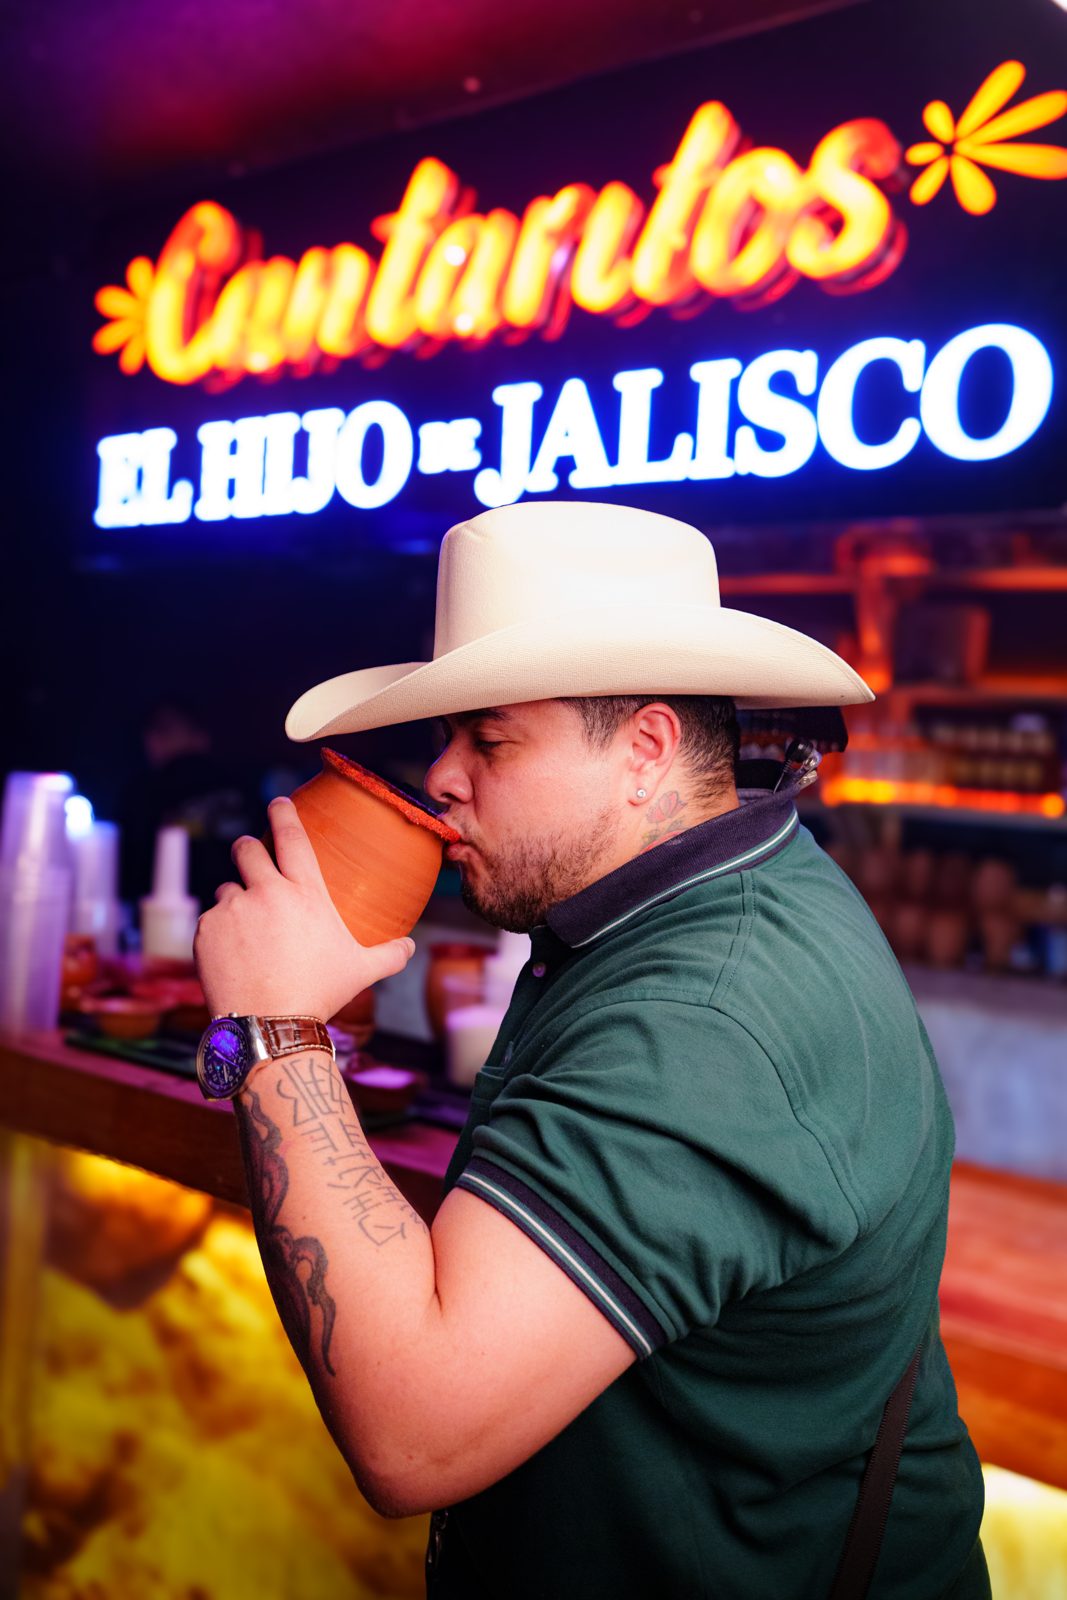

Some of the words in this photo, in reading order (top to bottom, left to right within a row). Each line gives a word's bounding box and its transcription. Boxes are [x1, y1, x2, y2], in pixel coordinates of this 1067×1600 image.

[147, 100, 902, 387] Cantaritos
[94, 427, 195, 529] EL
[194, 400, 414, 521] HIJO
[417, 417, 482, 475] DE
[473, 323, 1054, 508] JALISCO
